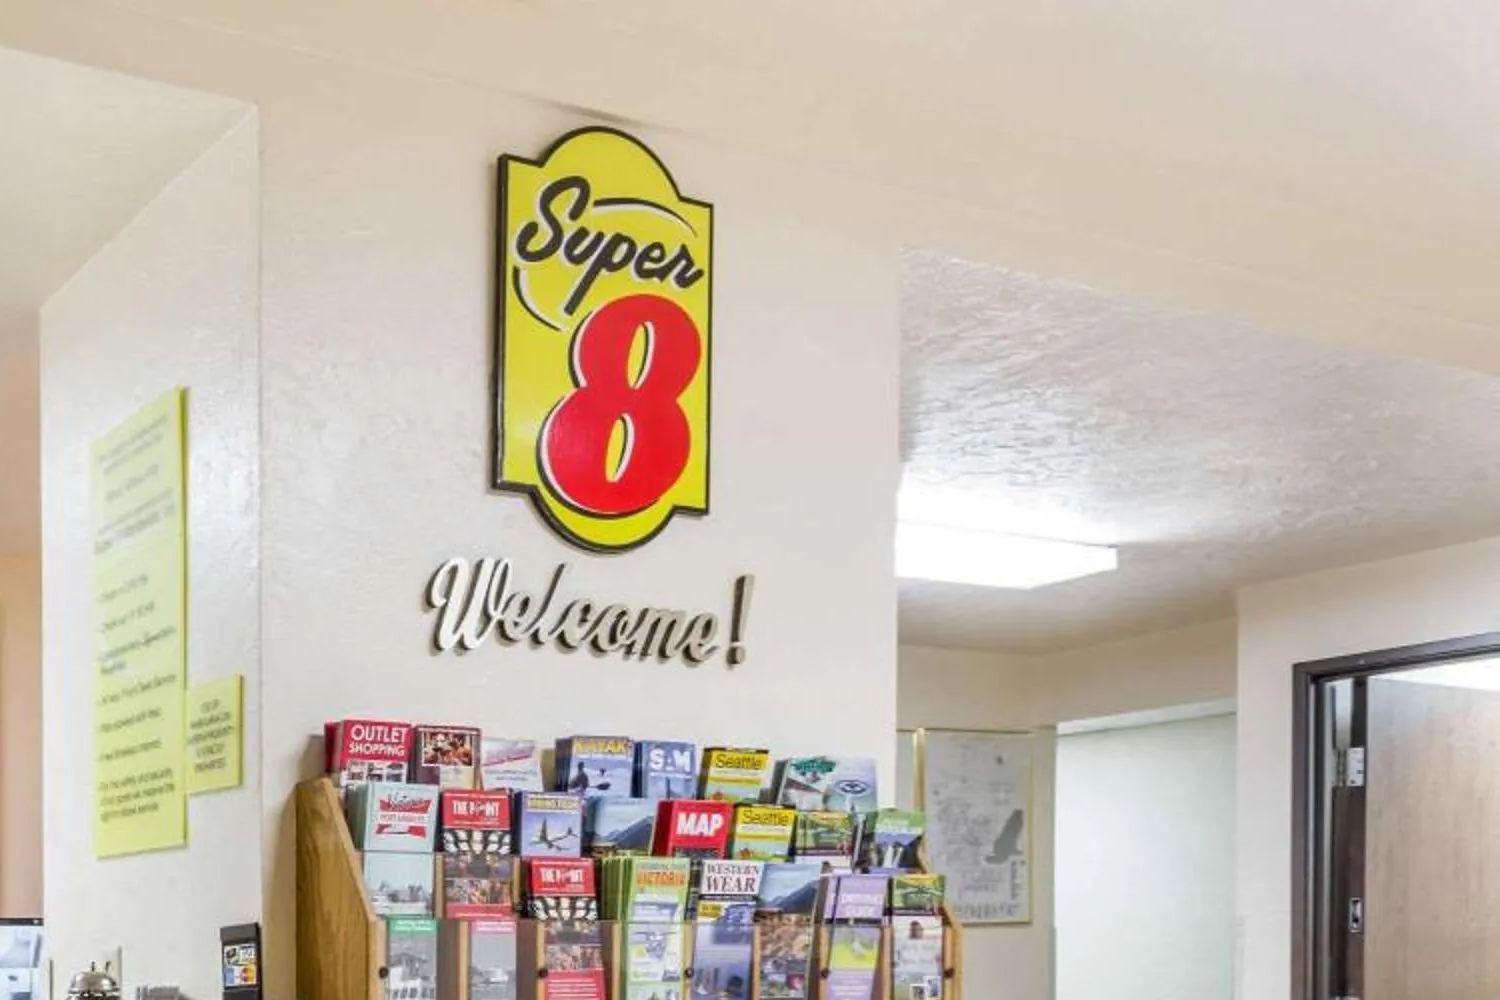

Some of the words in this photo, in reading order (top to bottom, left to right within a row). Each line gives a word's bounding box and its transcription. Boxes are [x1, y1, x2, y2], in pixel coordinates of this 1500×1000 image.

[516, 175, 704, 316] Super
[535, 293, 703, 516] 8
[424, 556, 756, 663] Welcome!
[351, 724, 408, 743] OUTLET
[349, 742, 405, 757] SHOPPING
[715, 753, 764, 770] Seattle
[452, 800, 468, 815] THE
[676, 811, 725, 837] MAP
[742, 809, 790, 826] Seattle
[540, 867, 555, 882] THE
[707, 863, 759, 875] WESTERN
[706, 875, 757, 892] WEAR
